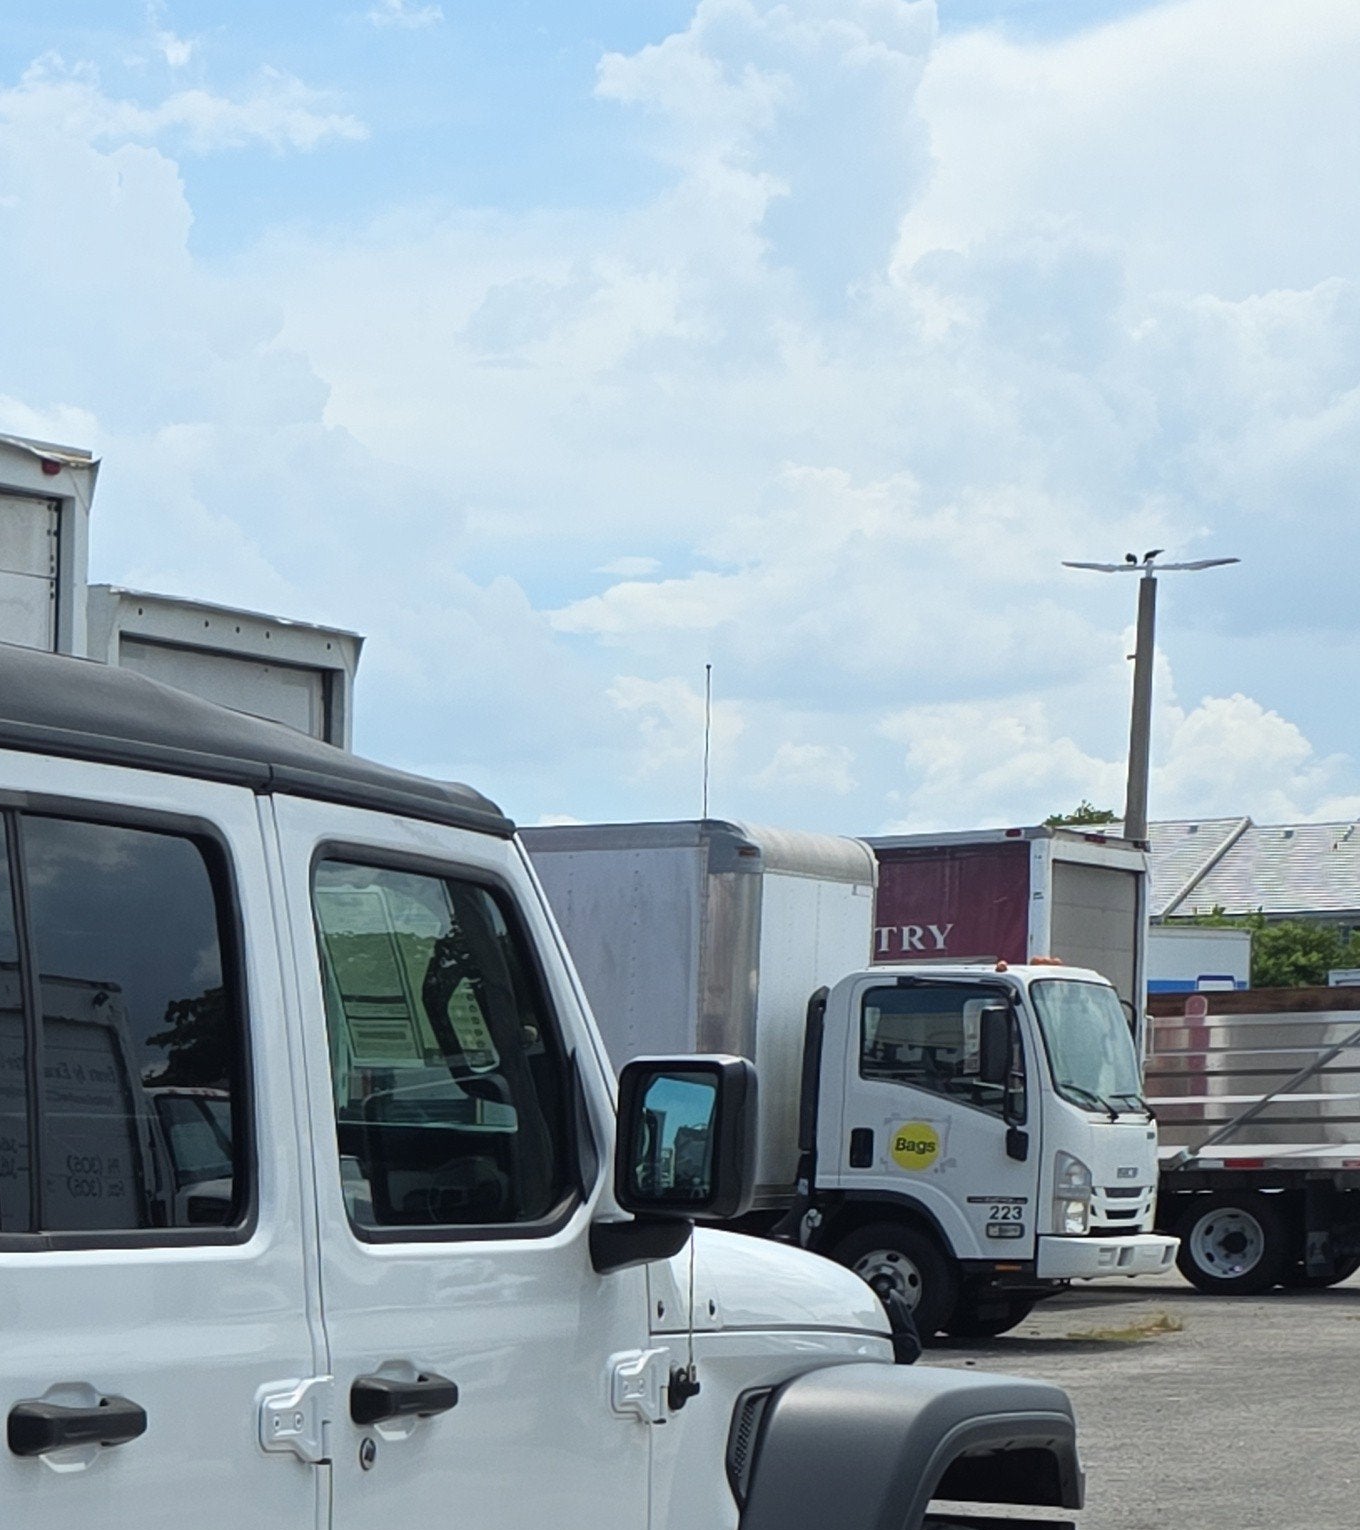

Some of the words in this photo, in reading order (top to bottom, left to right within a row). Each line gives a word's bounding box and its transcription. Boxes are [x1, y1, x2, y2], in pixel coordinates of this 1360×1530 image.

[875, 923, 954, 951] TRY
[895, 1137, 936, 1155] Bags
[989, 1206, 1023, 1220] 223
